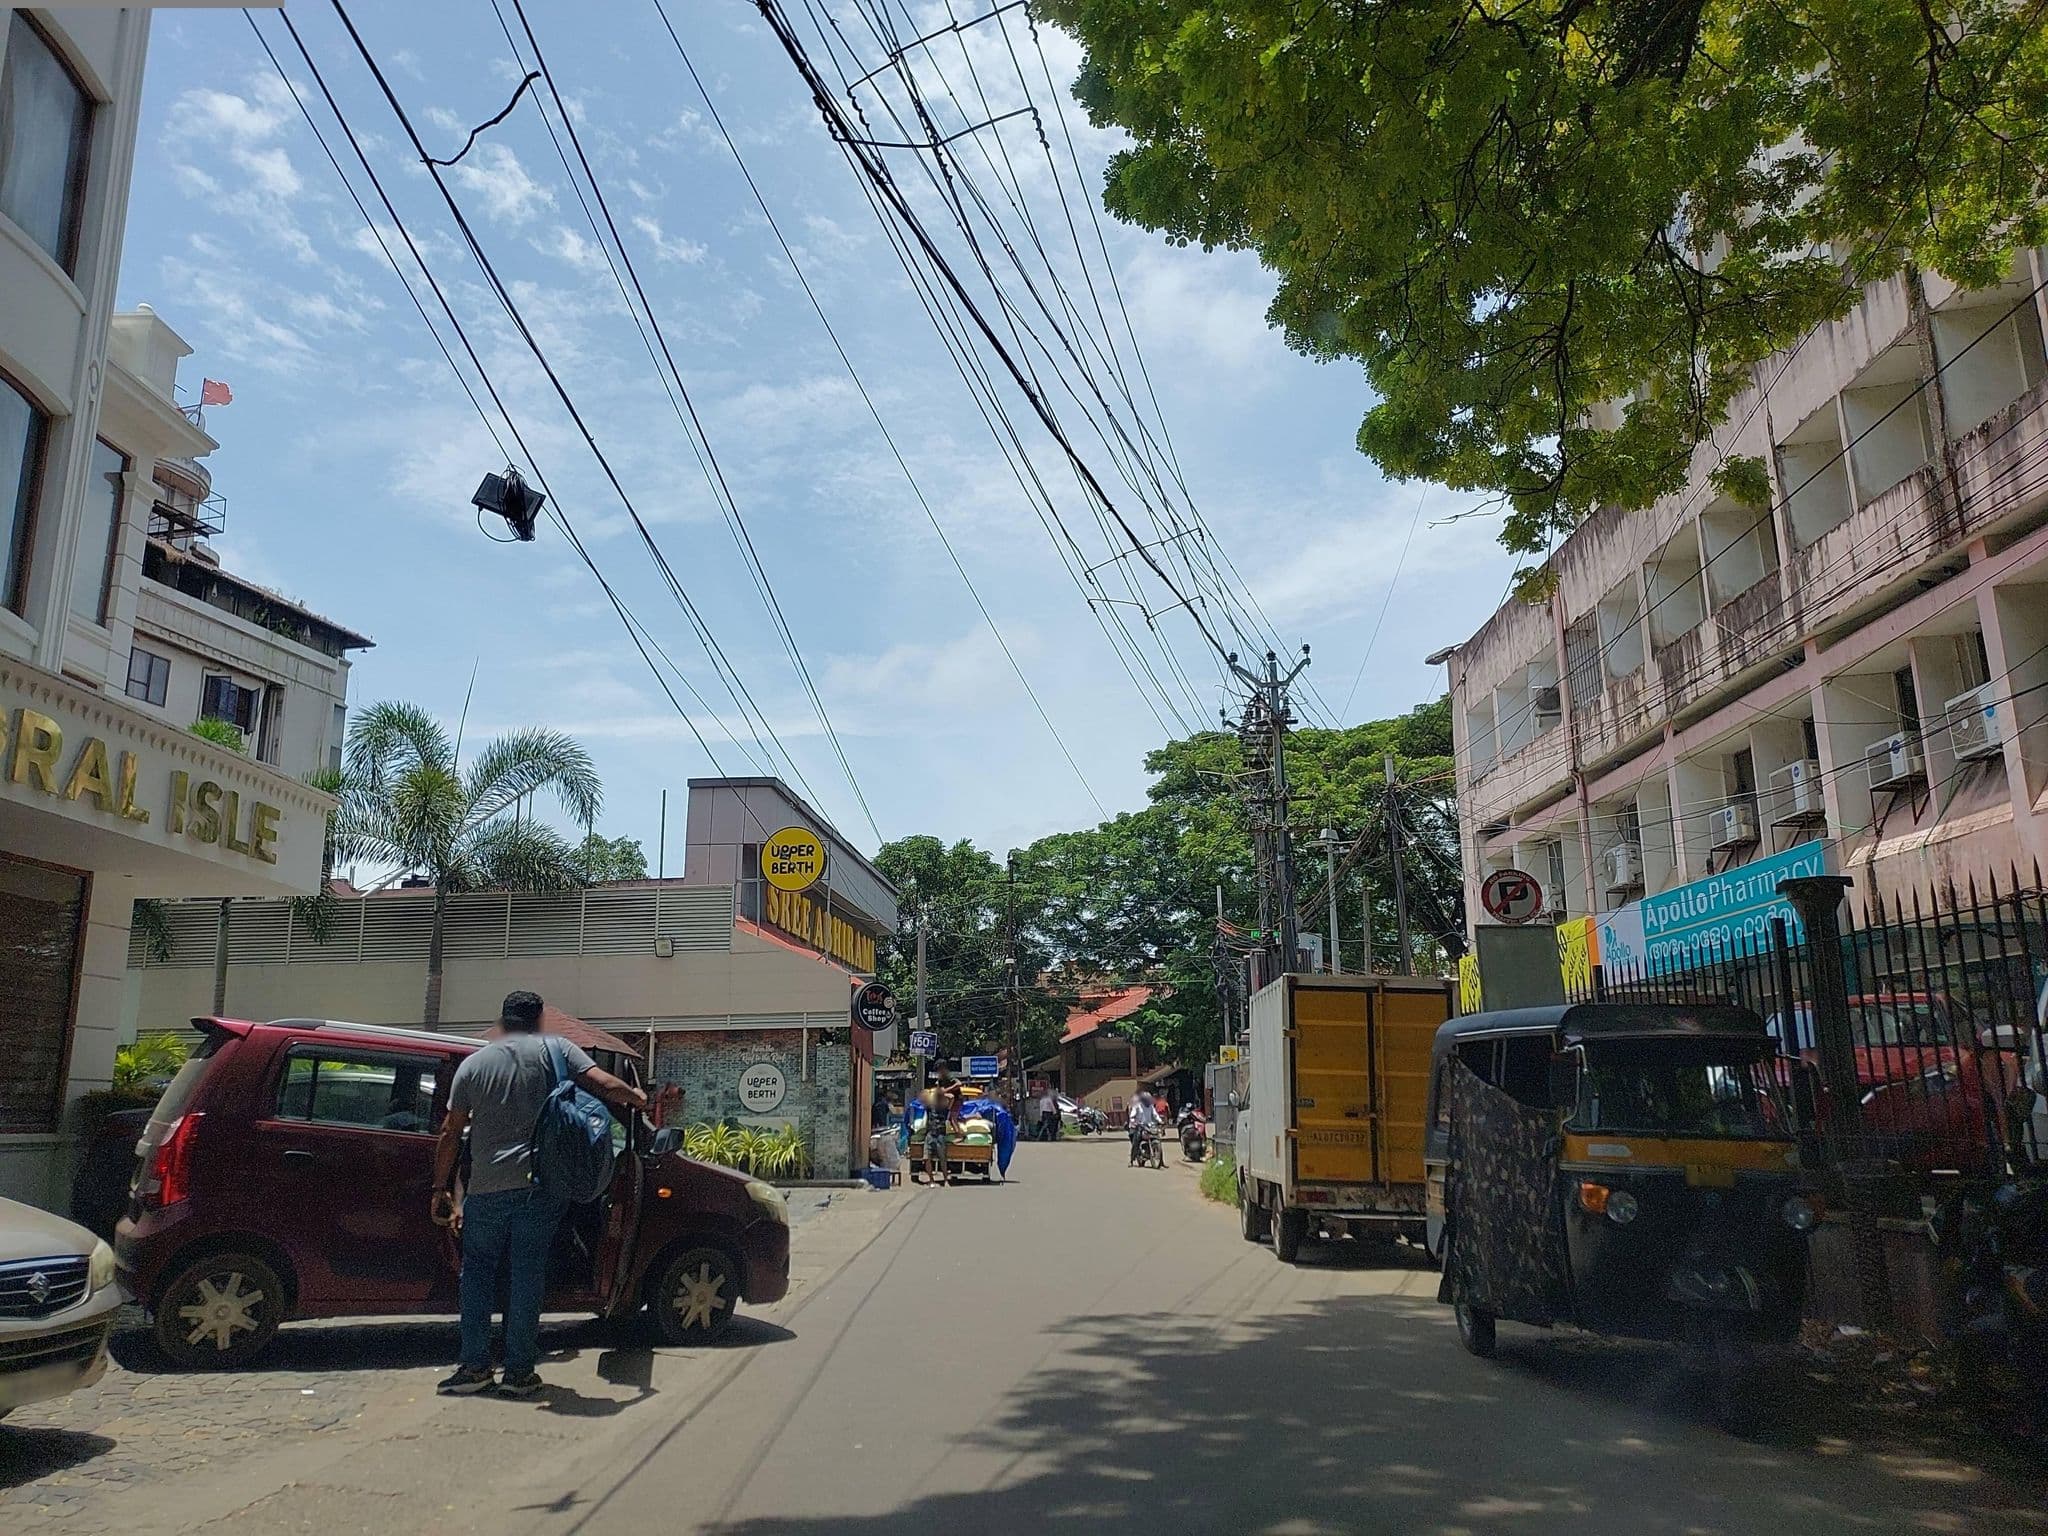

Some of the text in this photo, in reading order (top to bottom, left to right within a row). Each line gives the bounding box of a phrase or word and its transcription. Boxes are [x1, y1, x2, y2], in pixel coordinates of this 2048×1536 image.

[0, 705, 281, 865] RAL ISLE
[771, 844, 815, 860] UPPER
[771, 861, 814, 875] BERTH
[767, 884, 811, 942] SREE
[747, 1077, 777, 1088] UPPER
[748, 1090, 776, 1099] BERTH
